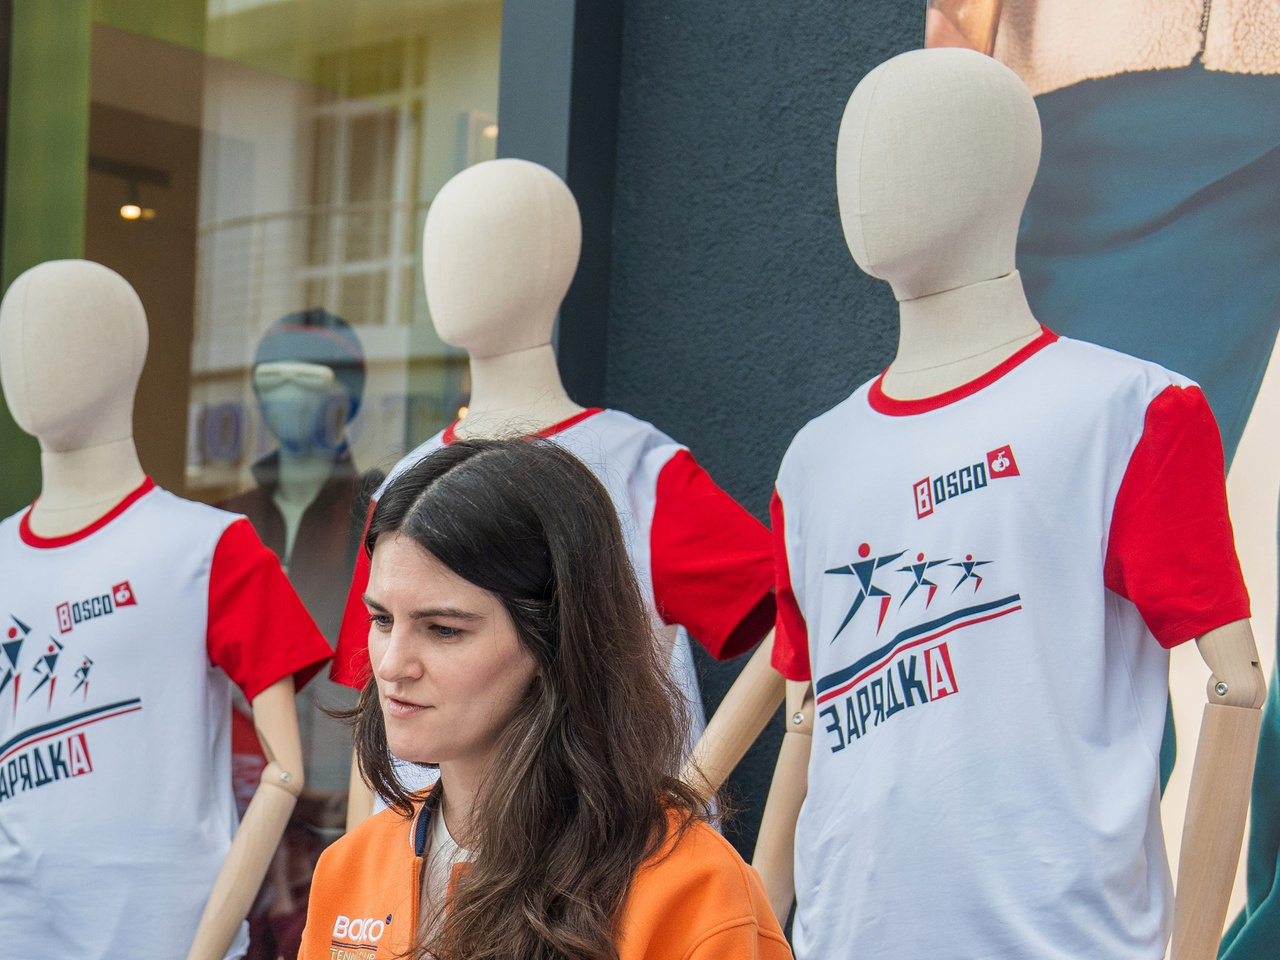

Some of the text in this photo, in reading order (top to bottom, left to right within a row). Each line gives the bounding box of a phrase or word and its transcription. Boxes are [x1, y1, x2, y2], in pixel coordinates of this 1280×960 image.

[913, 461, 987, 520] BOSCO
[56, 594, 113, 634] BOSCO
[819, 642, 959, 754] ЗАРЯДКА
[332, 914, 385, 942] BOCO
